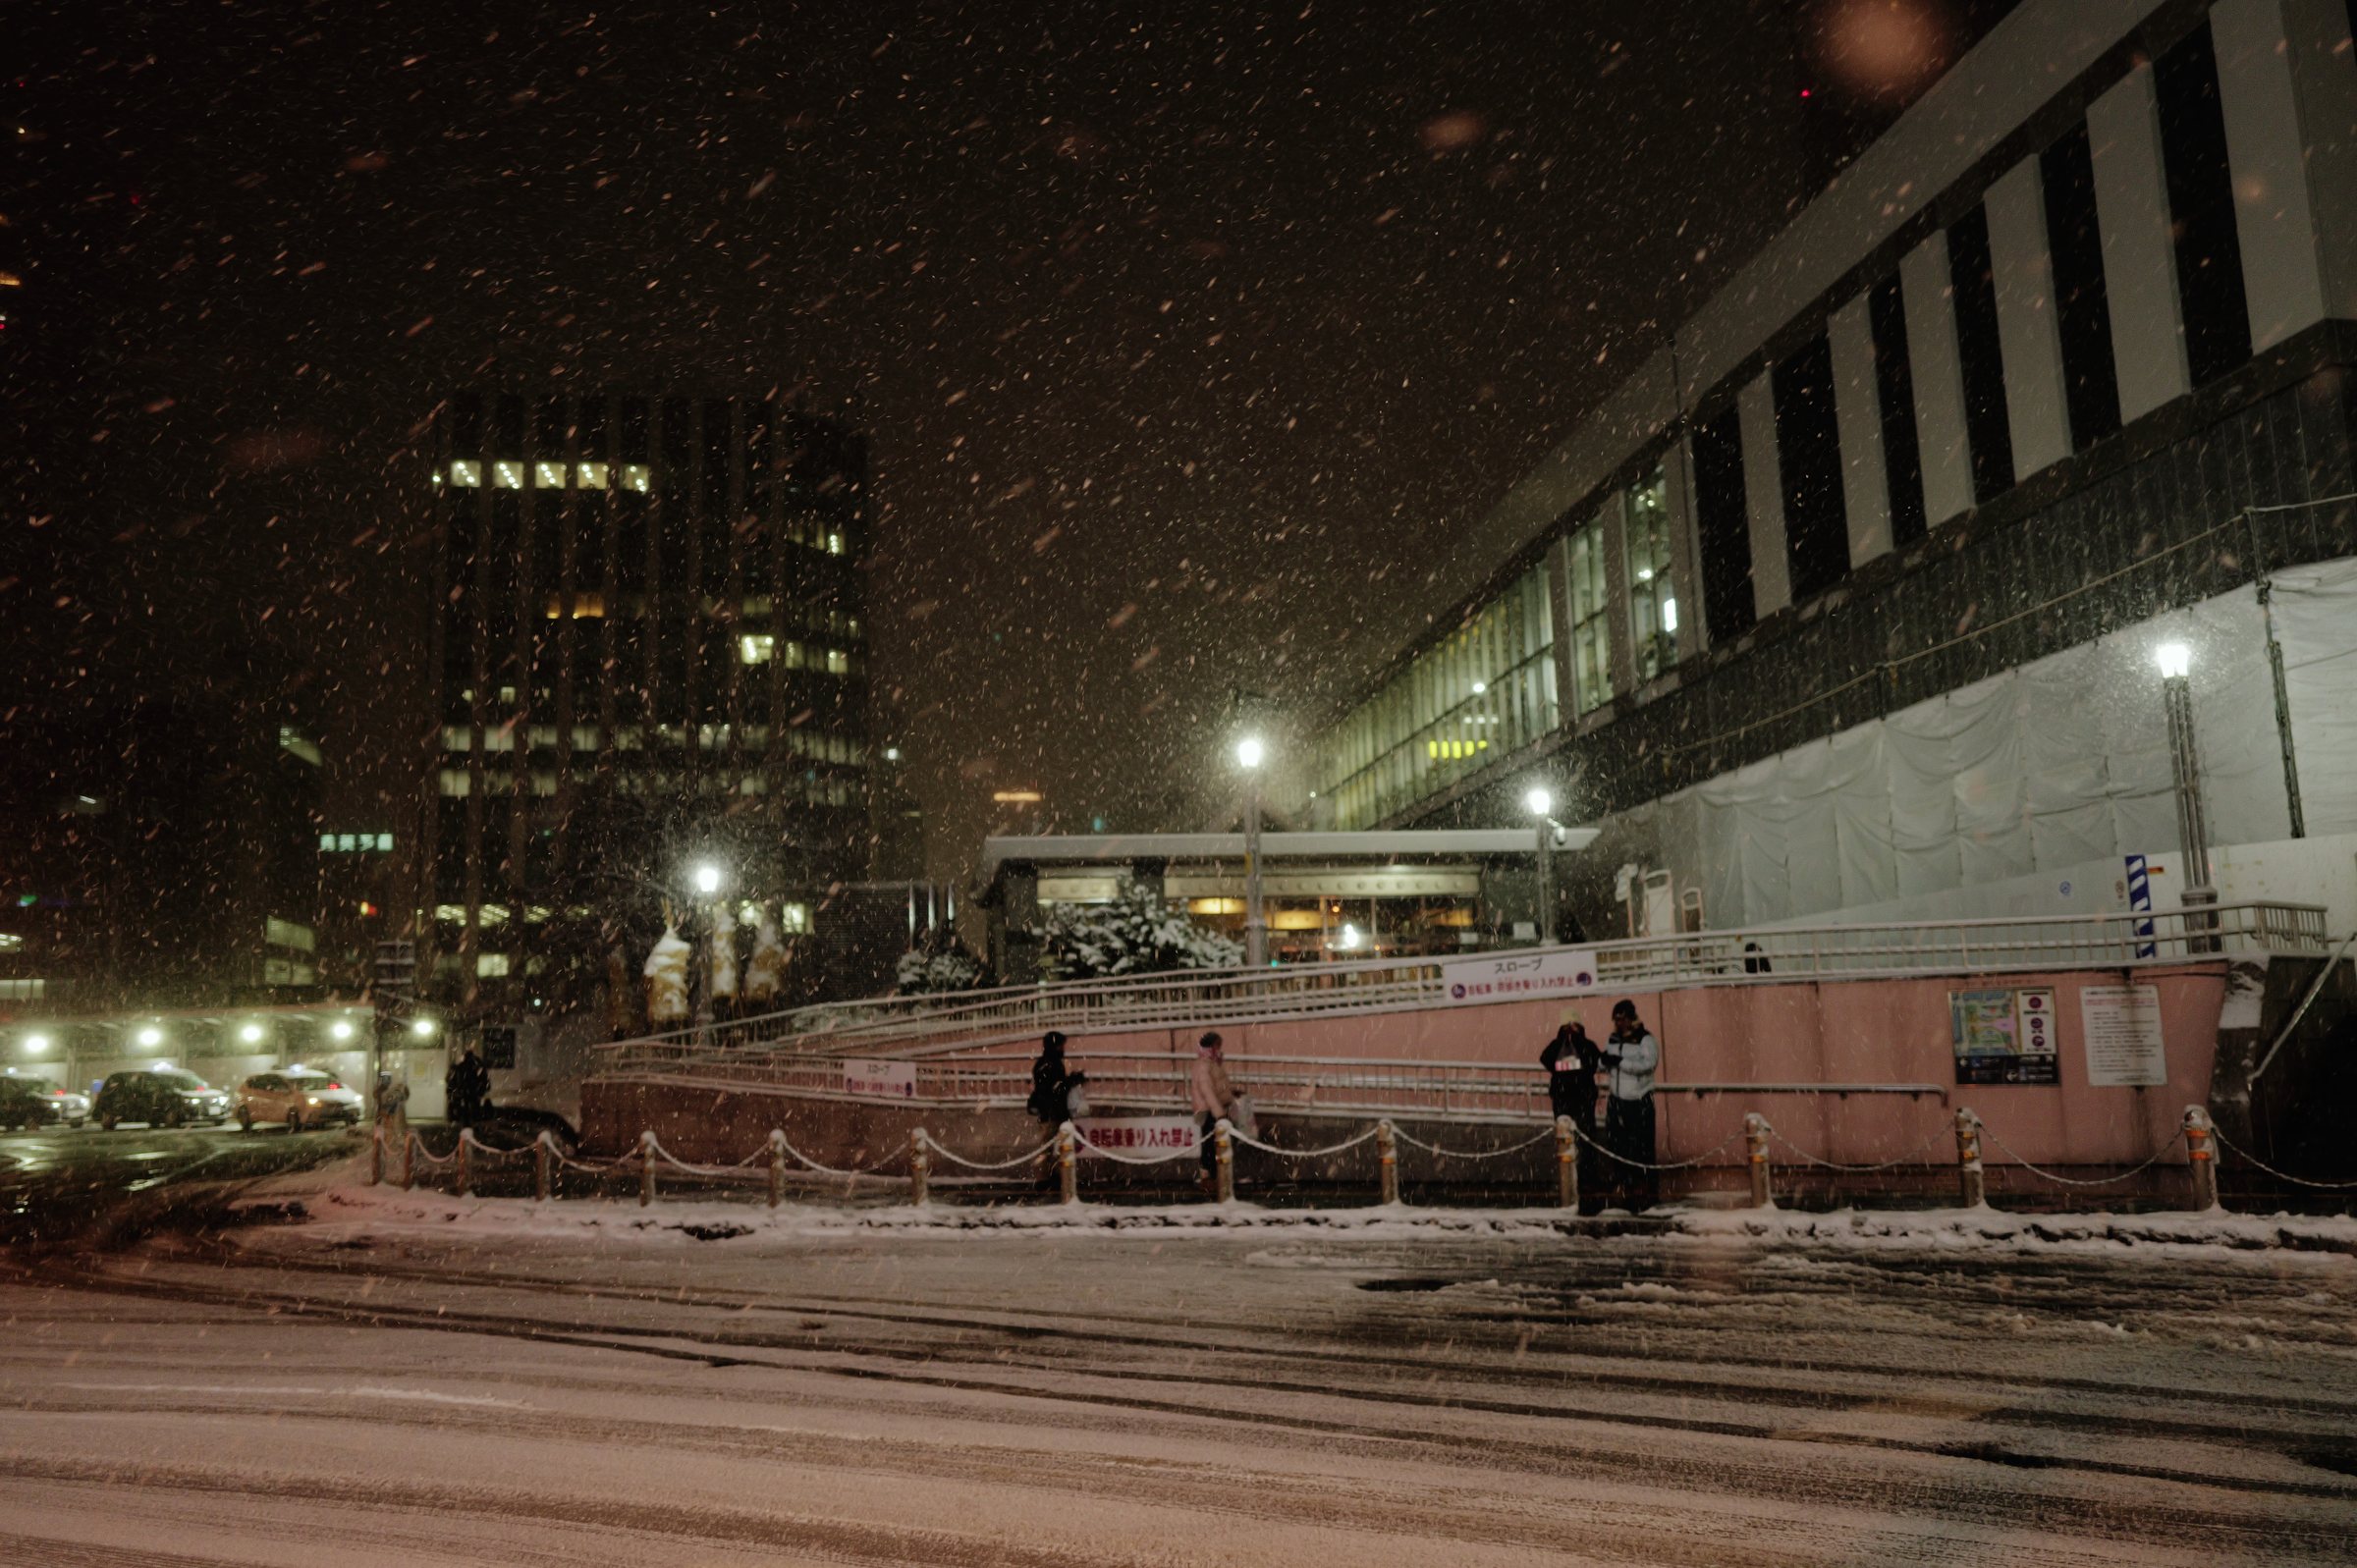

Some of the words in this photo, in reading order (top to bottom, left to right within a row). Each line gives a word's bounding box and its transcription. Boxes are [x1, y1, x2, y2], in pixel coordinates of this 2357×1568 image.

[1494, 957, 1543, 974] スロープ
[1089, 1127, 1194, 1147] 自転車乗り入れ禁止
